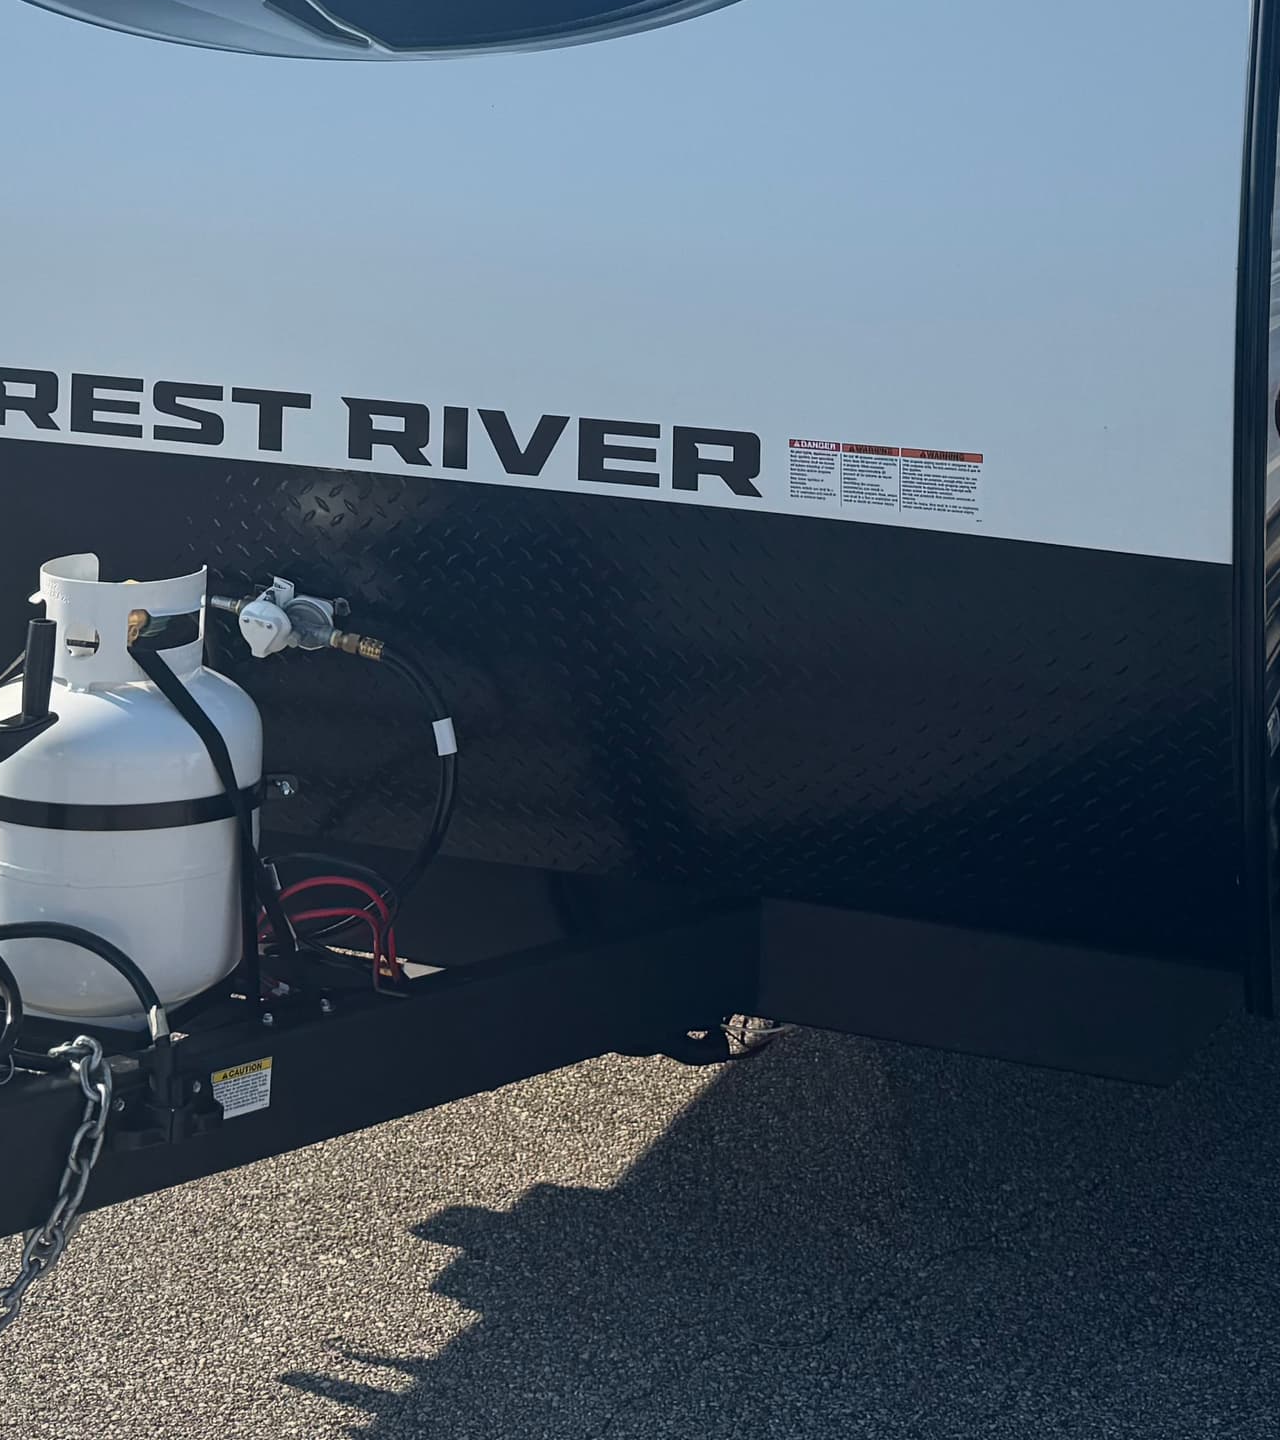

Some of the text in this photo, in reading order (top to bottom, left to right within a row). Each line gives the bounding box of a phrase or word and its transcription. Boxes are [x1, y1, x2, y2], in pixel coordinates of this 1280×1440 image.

[341, 396, 763, 498] RIVER
[799, 440, 836, 451] DANGER
[228, 1061, 263, 1077] CAUTION
